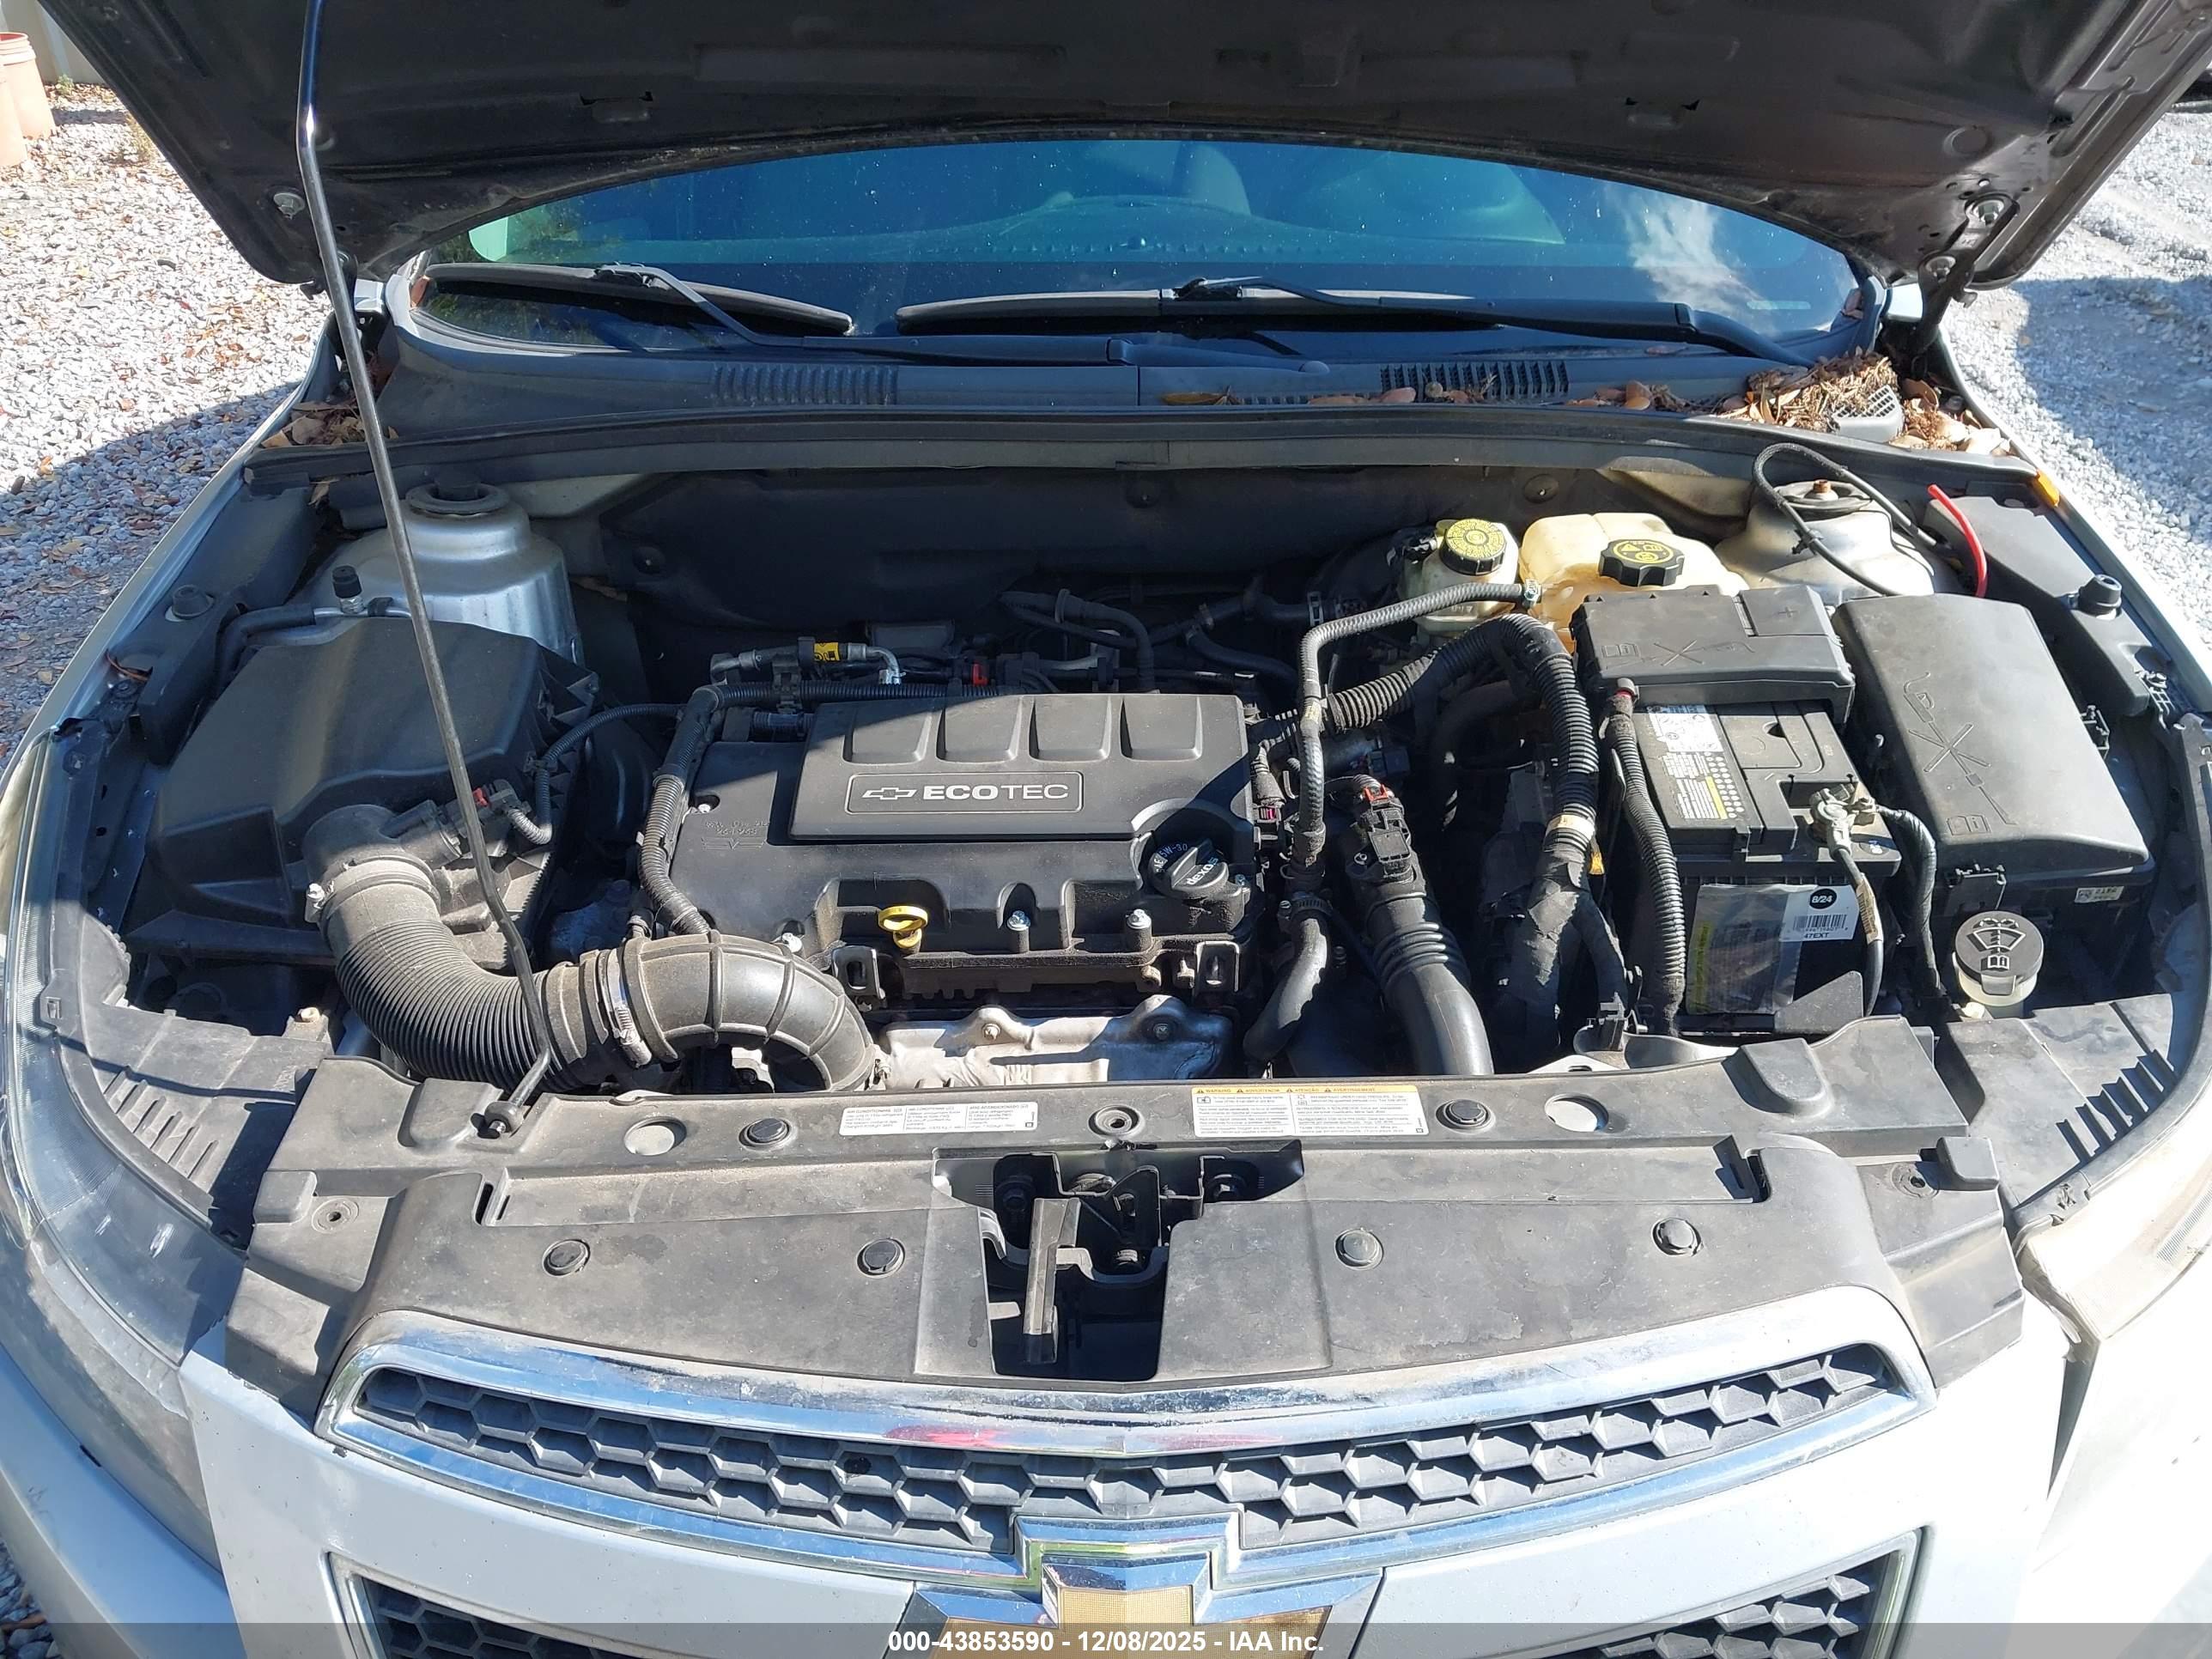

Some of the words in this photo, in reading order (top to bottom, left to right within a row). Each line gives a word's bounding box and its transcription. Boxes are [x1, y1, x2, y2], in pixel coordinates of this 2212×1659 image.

[922, 784, 1069, 800] ECOTEC
[1159, 843, 1188, 858] 5W-30
[1186, 856, 1219, 885] dexos
[1811, 895, 1833, 903] 8/24
